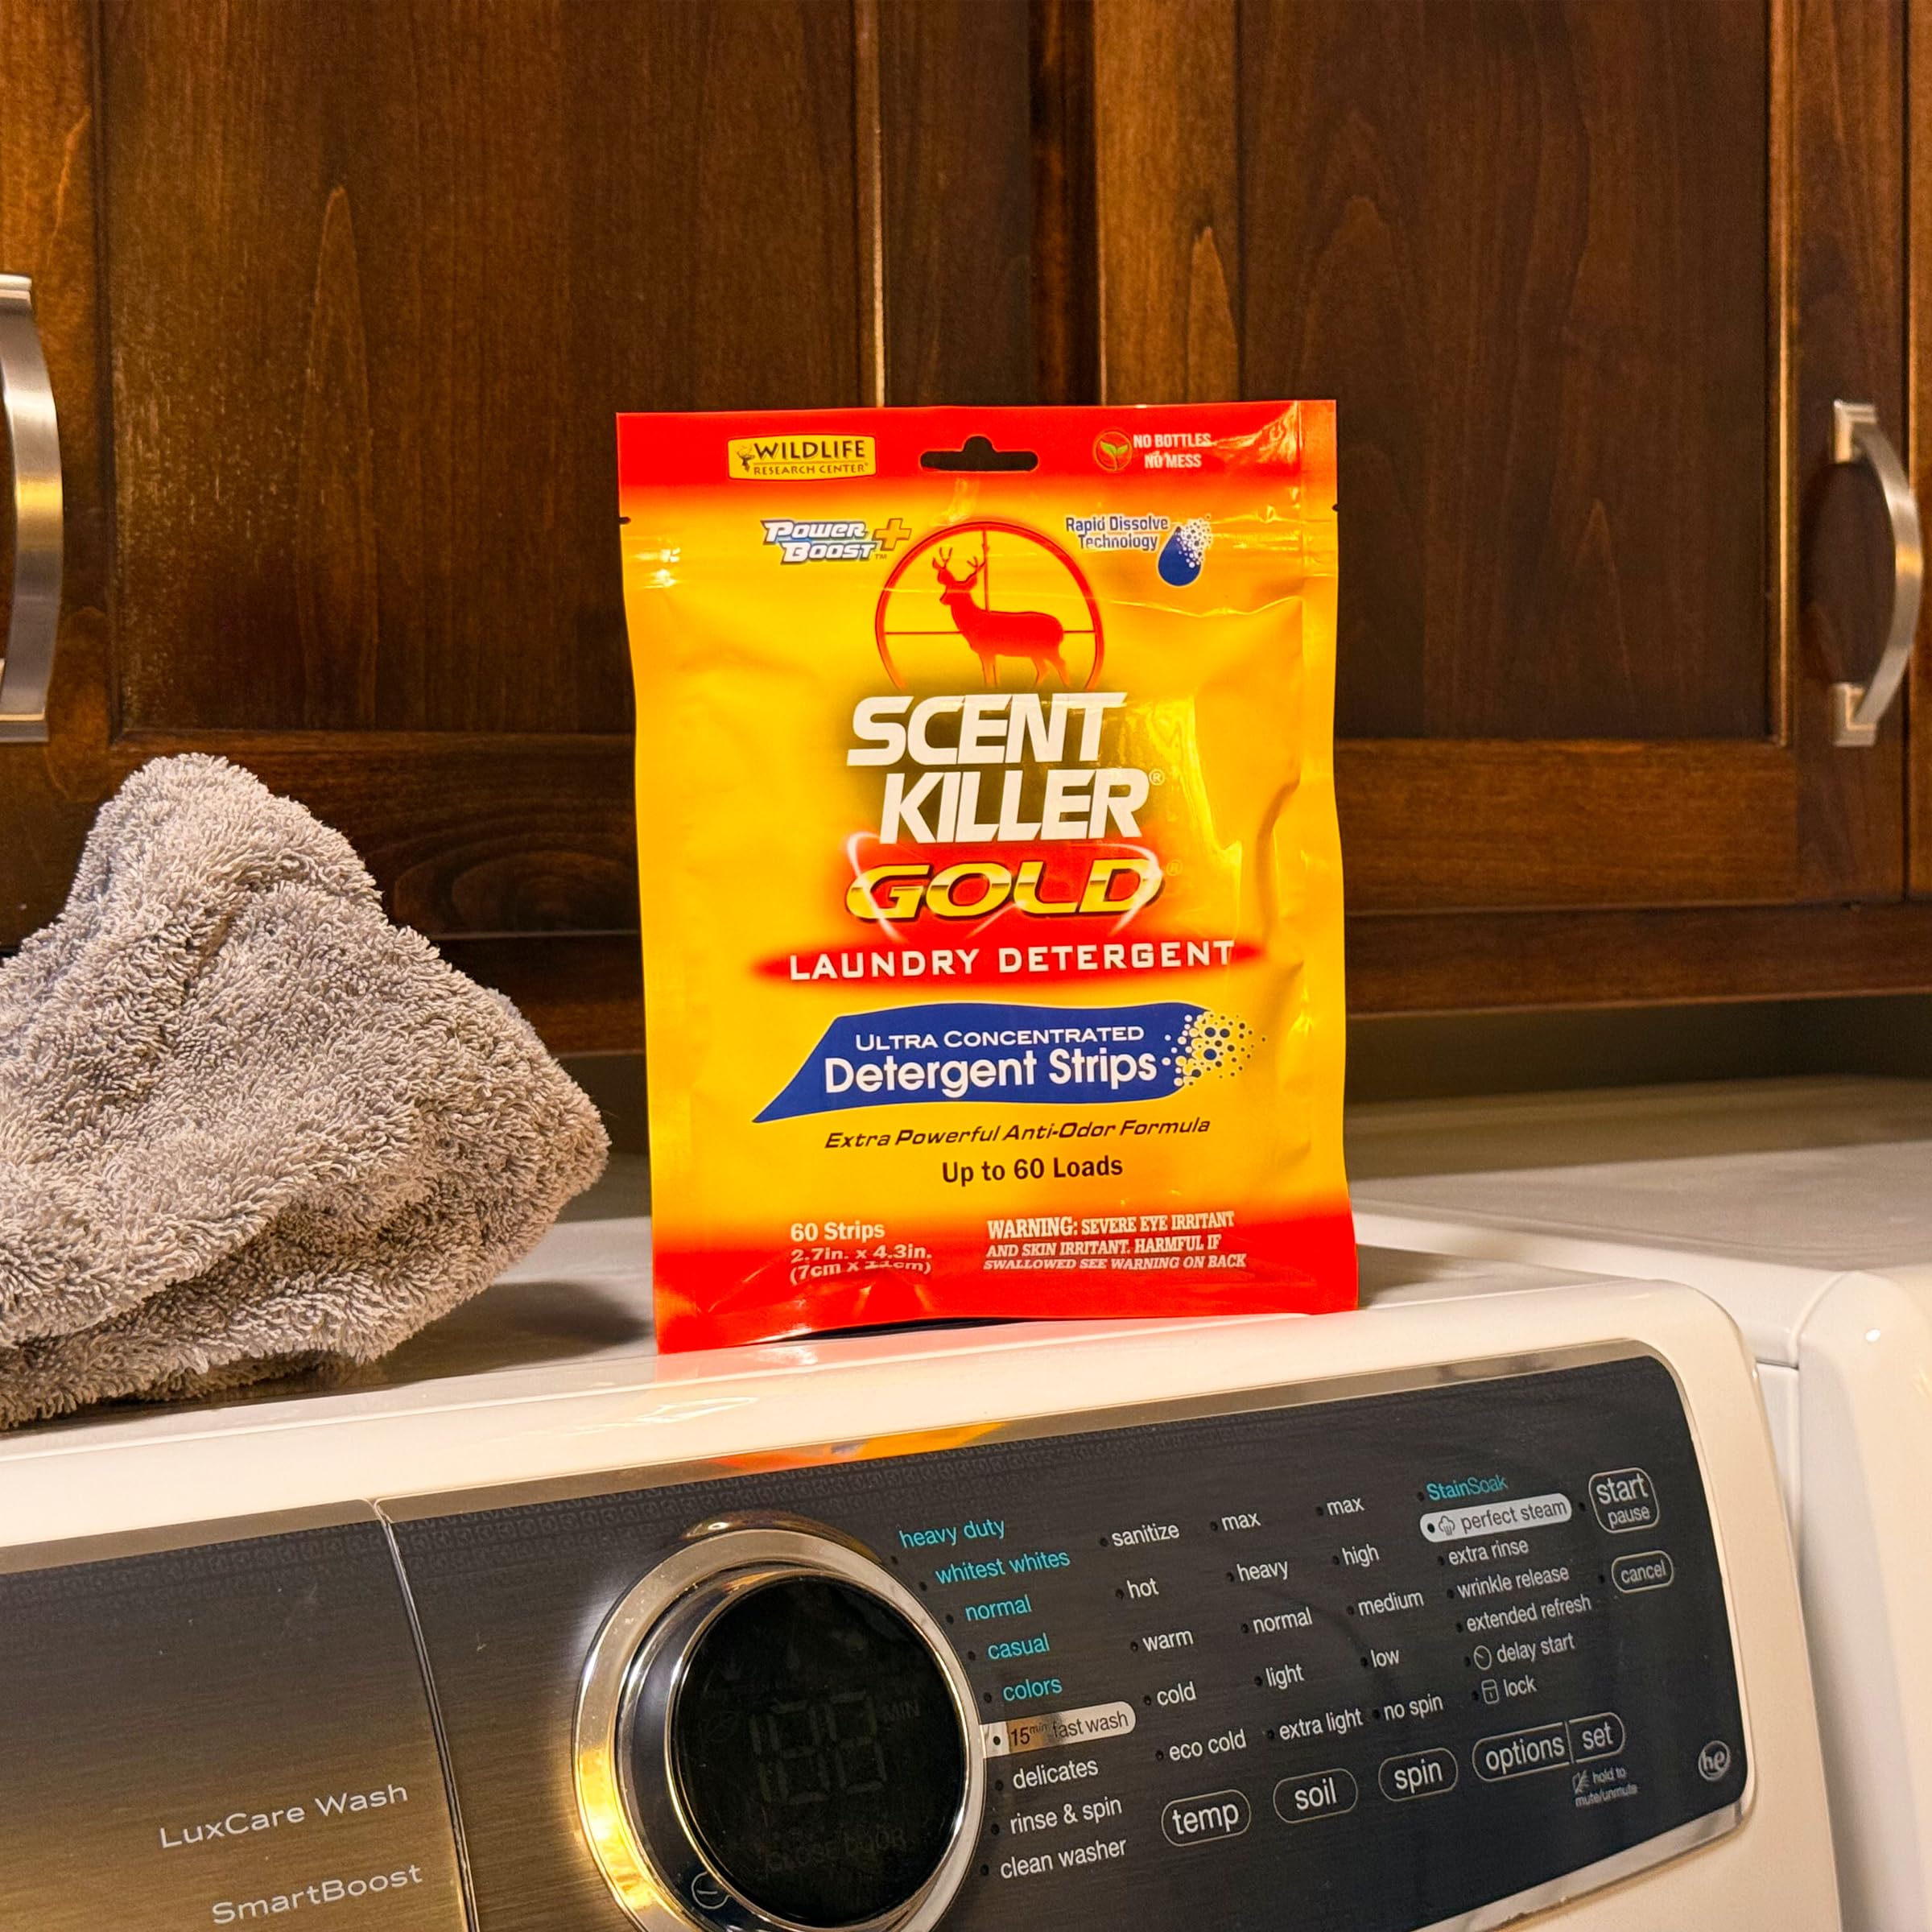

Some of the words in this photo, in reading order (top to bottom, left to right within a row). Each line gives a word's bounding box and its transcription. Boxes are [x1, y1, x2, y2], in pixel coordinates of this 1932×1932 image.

[753, 440, 865, 459] WILDLIFE
[1133, 435, 1153, 448] NO
[1154, 433, 1212, 448] BOTTLES
[753, 465, 816, 476] RESEARCH
[1145, 455, 1162, 469] NO
[1166, 454, 1202, 468] MESS
[1066, 516, 1105, 535] Rapid
[1109, 515, 1169, 531] Dissolve
[1078, 534, 1158, 551] Technology
[846, 692, 1127, 766] SCENT
[790, 948, 980, 981] LAUNDRY
[998, 940, 1235, 972] DETERGENT
[824, 1053, 1037, 1098] Detergent
[1048, 1048, 1157, 1090] Strips
[824, 1132, 890, 1149] Extra
[894, 1125, 1001, 1146] Powerful
[1003, 1122, 1116, 1141] Anti-Odor
[1119, 1117, 1211, 1137] Formula
[942, 1162, 974, 1187] Up
[981, 1161, 1005, 1181] to
[1013, 1158, 1045, 1179] 60
[1053, 1155, 1123, 1178] Loads
[791, 1222, 819, 1241] 60
[824, 1220, 886, 1243] Strips
[987, 1216, 1078, 1240] WARNING:
[1081, 1216, 1137, 1235] SEVERE
[1140, 1215, 1168, 1232] EYE
[1171, 1211, 1235, 1230] IRRITANT
[791, 1247, 849, 1264] 2.7in.
[856, 1249, 867, 1259] x
[873, 1244, 932, 1259] 4.3in.
[986, 1244, 1019, 1257] AND
[1022, 1242, 1057, 1257] SKIN
[1134, 1235, 1204, 1253] HARMFUL
[1208, 1234, 1222, 1249] IF
[790, 1263, 841, 1286] (7cm
[847, 1261, 859, 1272] x
[983, 1259, 1076, 1269] SWALLOWED
[1080, 1258, 1108, 1269] SEE
[1111, 1257, 1180, 1270] WARNING
[1183, 1256, 1206, 1269] ON
[1208, 1253, 1247, 1269] BACK
[1426, 1475, 1508, 1501] StainSoak
[1596, 1473, 1649, 1505] start
[1327, 1498, 1364, 1516] max
[1461, 1506, 1517, 1534] perfect
[1521, 1500, 1567, 1520] steam
[1608, 1505, 1650, 1530] pause
[898, 1527, 957, 1548] heavy
[964, 1518, 1005, 1540] duty
[1112, 1522, 1180, 1547] sanitize
[1220, 1513, 1261, 1531] max
[1342, 1543, 1380, 1567] high
[1448, 1544, 1488, 1565] extra
[1492, 1539, 1529, 1558] rinse
[935, 1558, 1006, 1585] whitest
[1009, 1550, 1071, 1574] whites
[1236, 1561, 1288, 1582] heavy
[1620, 1560, 1666, 1584] cancel
[1127, 1578, 1159, 1599] hot
[1457, 1574, 1513, 1599] wrinkle
[1515, 1567, 1570, 1590] release
[965, 1594, 1031, 1622] normal
[1358, 1591, 1424, 1616] medium
[1467, 1604, 1538, 1633] extended
[1541, 1594, 1591, 1618] refresh
[1253, 1607, 1313, 1634] normal
[987, 1633, 1050, 1660] casual
[1142, 1629, 1194, 1652] warm
[1496, 1641, 1536, 1665] delay
[1540, 1633, 1575, 1653] start
[1371, 1649, 1399, 1668] low
[1002, 1677, 1063, 1702] colors
[1265, 1664, 1304, 1689] light
[1504, 1674, 1538, 1697] lock
[1157, 1682, 1196, 1706] cold
[1384, 1702, 1405, 1720] no
[1410, 1694, 1443, 1719] spin
[1052, 1719, 1083, 1739] fast
[1085, 1711, 1129, 1733] wash
[1279, 1718, 1323, 1740] extra
[1326, 1708, 1363, 1734] light
[1582, 1722, 1614, 1750] set
[1169, 1740, 1203, 1761] eco
[1208, 1729, 1246, 1753] cold
[1486, 1734, 1565, 1774] options
[1013, 1758, 1099, 1790] delicates
[1394, 1759, 1443, 1794] spin
[1591, 1769, 1614, 1785] hold
[1616, 1767, 1626, 1779] to
[1294, 1777, 1337, 1810] soil
[159, 1806, 306, 1849] LuxCare
[315, 1783, 408, 1817] Wash
[1010, 1810, 1058, 1835] rinse
[1063, 1804, 1078, 1824] &
[1083, 1796, 1122, 1823] spin
[1172, 1802, 1240, 1835] temp
[1001, 1852, 1053, 1879] clean
[1058, 1839, 1126, 1868] washer
[212, 1864, 423, 1924] SmartBoost
